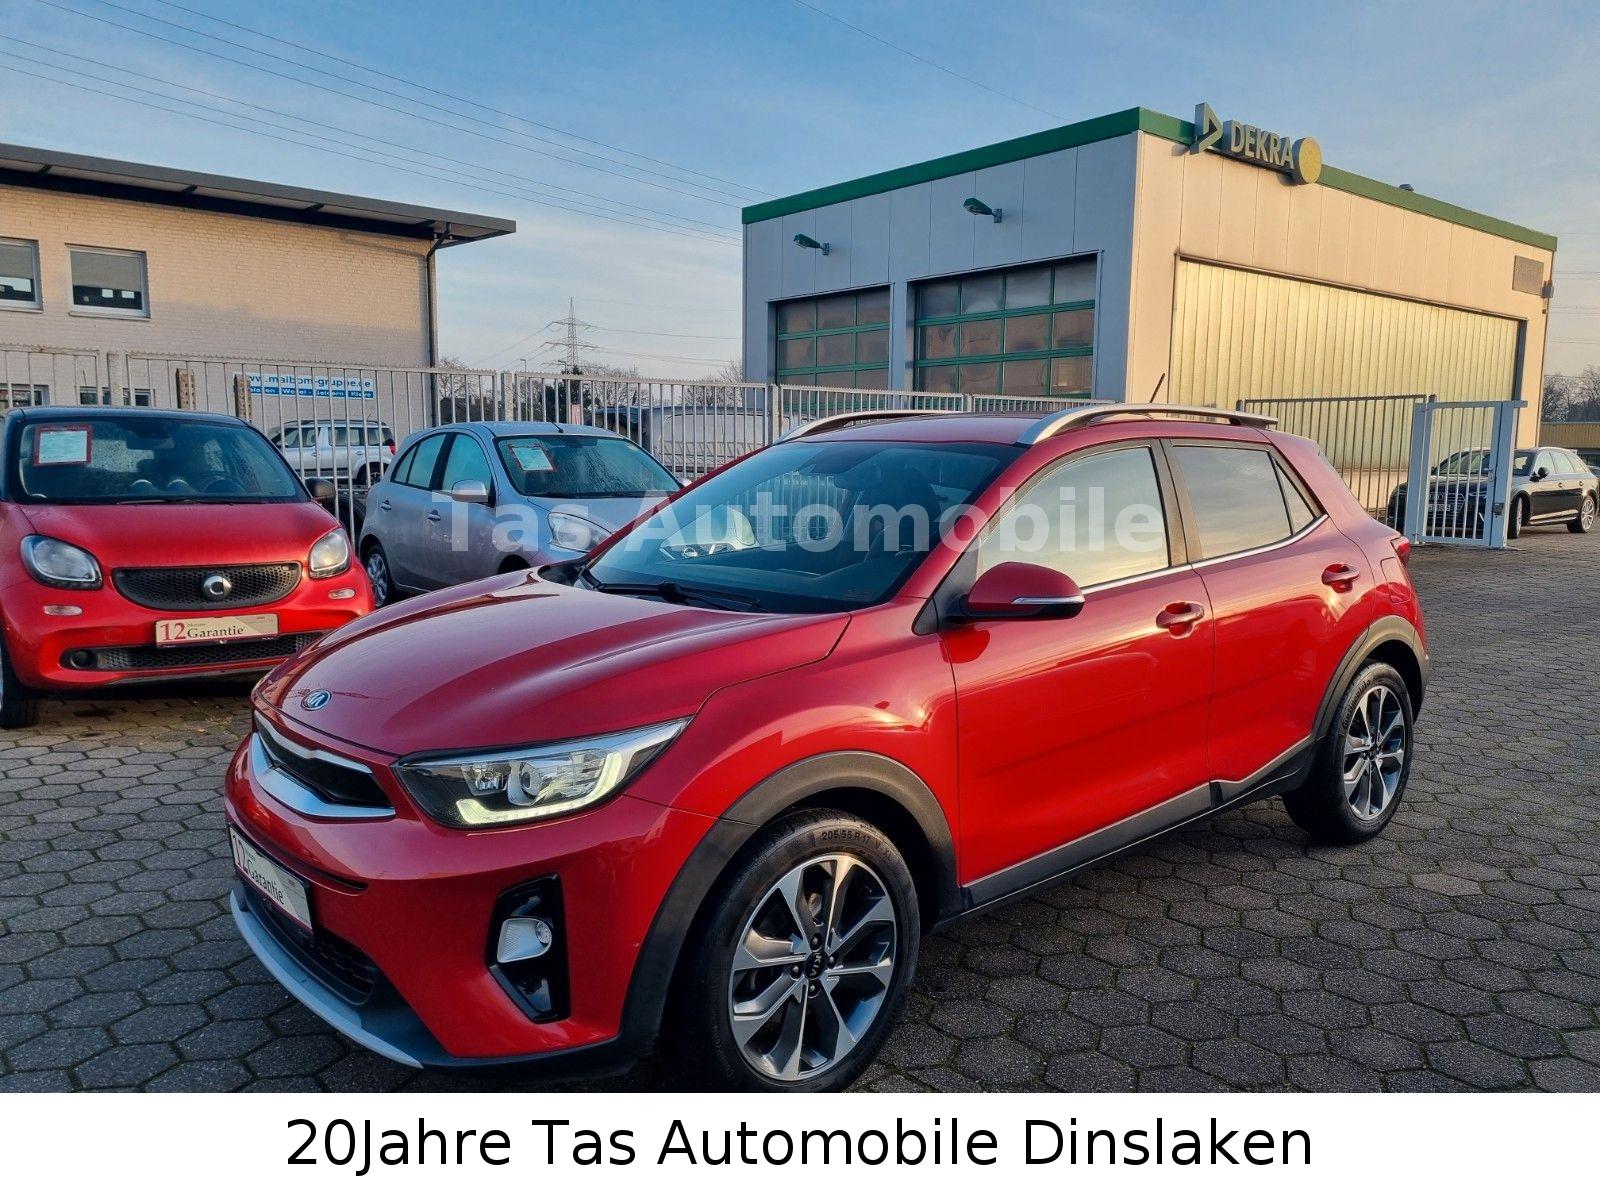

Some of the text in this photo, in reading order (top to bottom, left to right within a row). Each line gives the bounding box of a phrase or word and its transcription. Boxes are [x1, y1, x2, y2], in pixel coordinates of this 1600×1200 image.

[1229, 120, 1295, 169] DEKRA
[160, 622, 244, 640] 12 Garantie
[822, 829, 852, 841] 205/55
[854, 832, 861, 840] R
[862, 834, 871, 844] 17
[247, 859, 284, 905] Garantie
